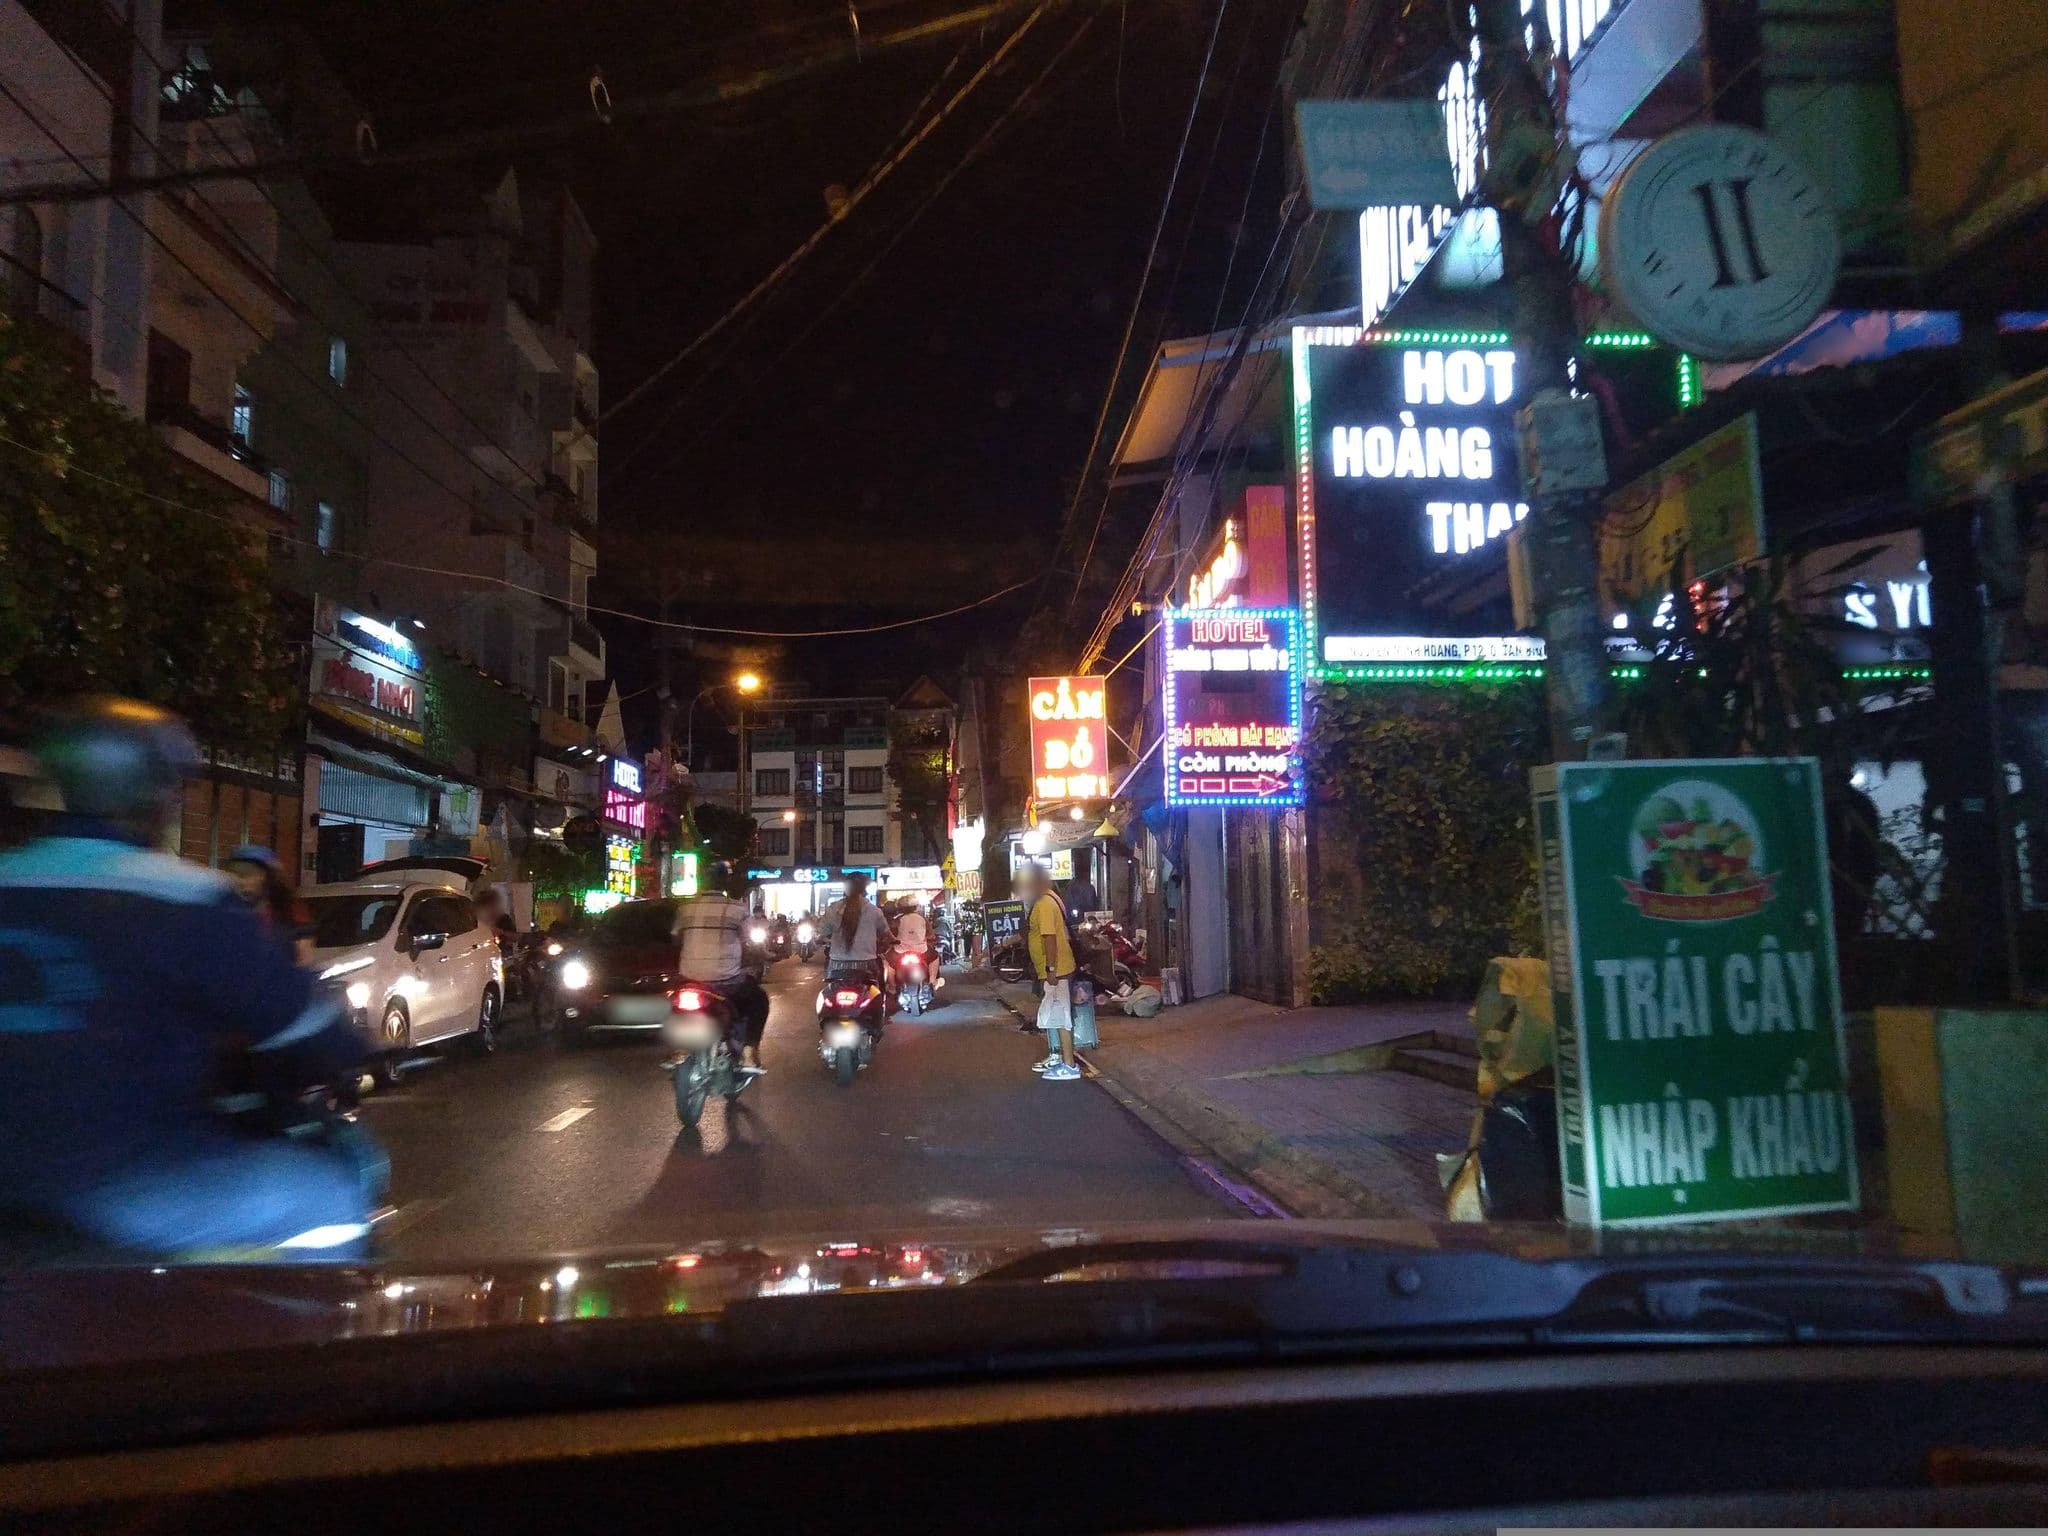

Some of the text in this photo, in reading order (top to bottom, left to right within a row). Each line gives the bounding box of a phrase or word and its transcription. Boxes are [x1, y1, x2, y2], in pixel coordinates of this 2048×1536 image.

[1332, 411, 1493, 480] HOÀNG
[1191, 618, 1270, 643] HOTEL
[613, 759, 642, 794] HOTEL
[1178, 750, 1288, 773] CÒN PHÒNG
[793, 868, 829, 882] GS25
[1594, 934, 1818, 1041] TRÁI CÂY
[1600, 1057, 1841, 1203] NHẬP KHẨU
